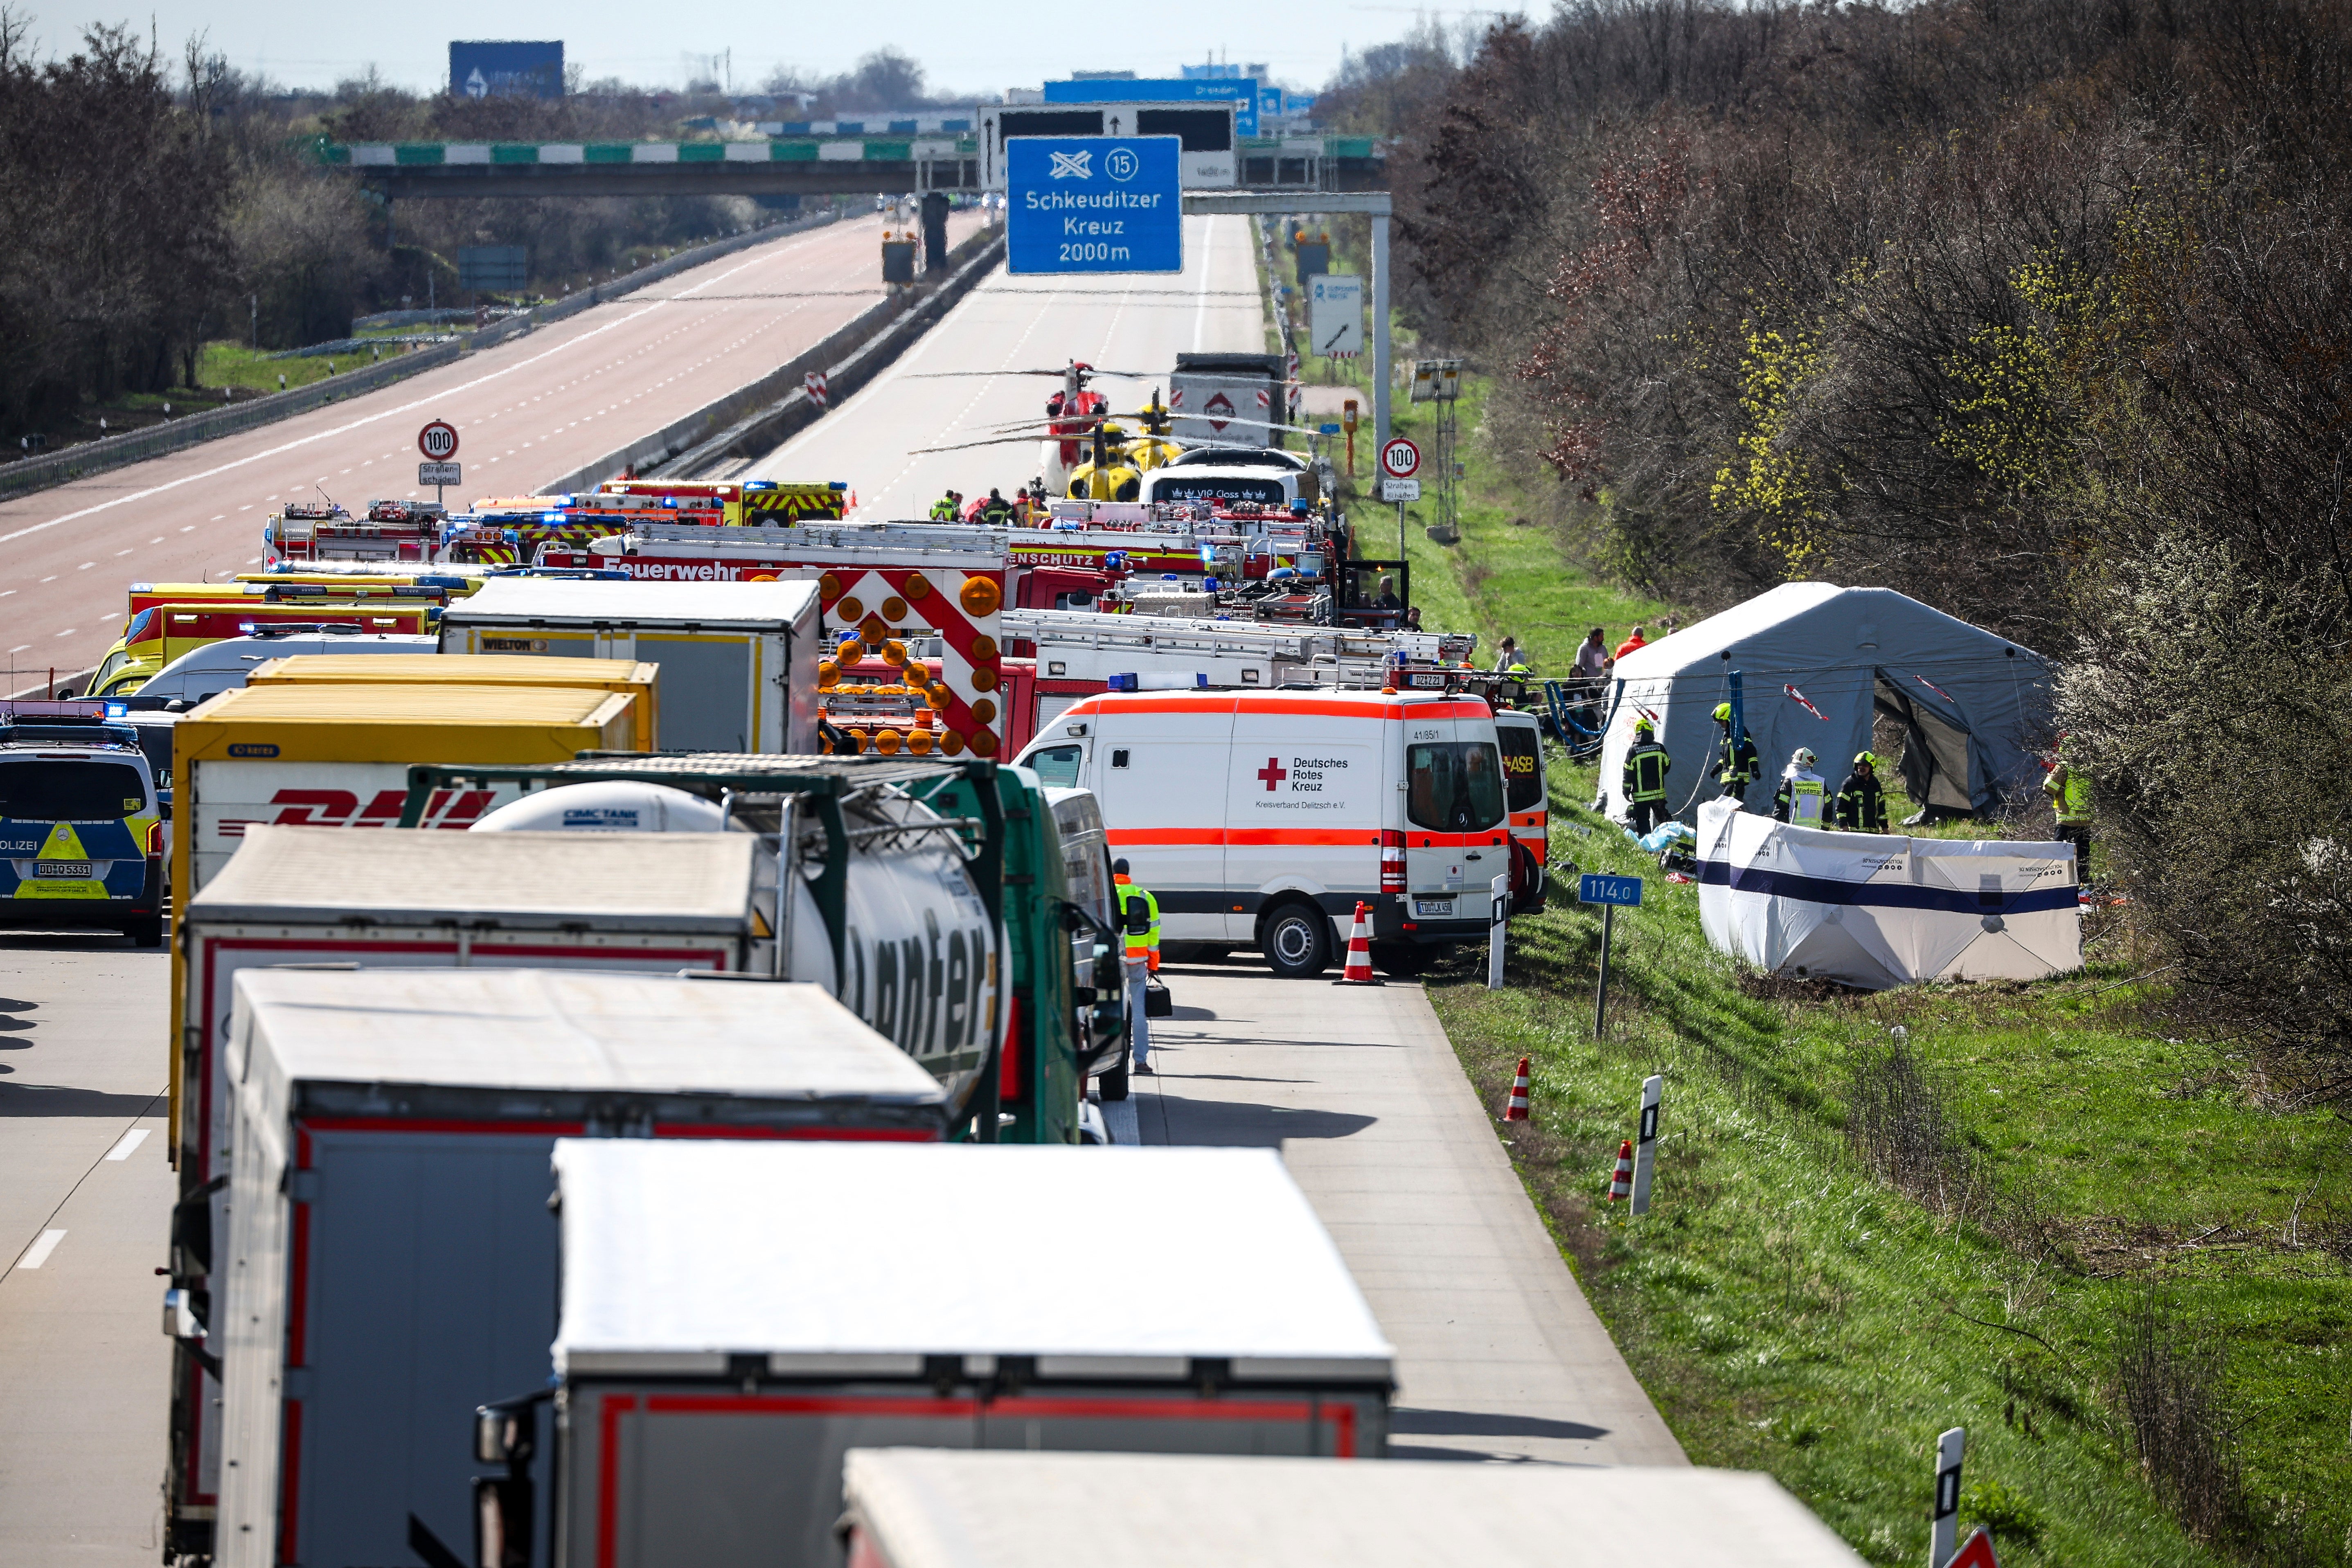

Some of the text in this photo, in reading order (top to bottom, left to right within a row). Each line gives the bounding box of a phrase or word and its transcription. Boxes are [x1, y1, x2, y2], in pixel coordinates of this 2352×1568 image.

[1112, 155, 1131, 174] 15
[1026, 190, 1161, 210] Schkeuditzer
[1064, 216, 1124, 235] Kreuz
[1059, 243, 1131, 261] 2000 m
[426, 432, 451, 450] 100
[1390, 449, 1413, 466] 100
[1197, 489, 1239, 498] VIP Class
[1009, 553, 1094, 565] ENSCHUTZ
[603, 557, 741, 581] Feuerwehr
[483, 638, 531, 650] WIELTON
[1416, 675, 1424, 685] DZ
[1293, 757, 1348, 768] Deutsches
[1510, 756, 1534, 773] ASB
[1293, 770, 1322, 779] Rotes
[1292, 781, 1322, 791] Kreuz
[0, 841, 37, 850] OLIZEI
[40, 865, 90, 874] DD Q 5331
[1591, 880, 1631, 900] 114,0
